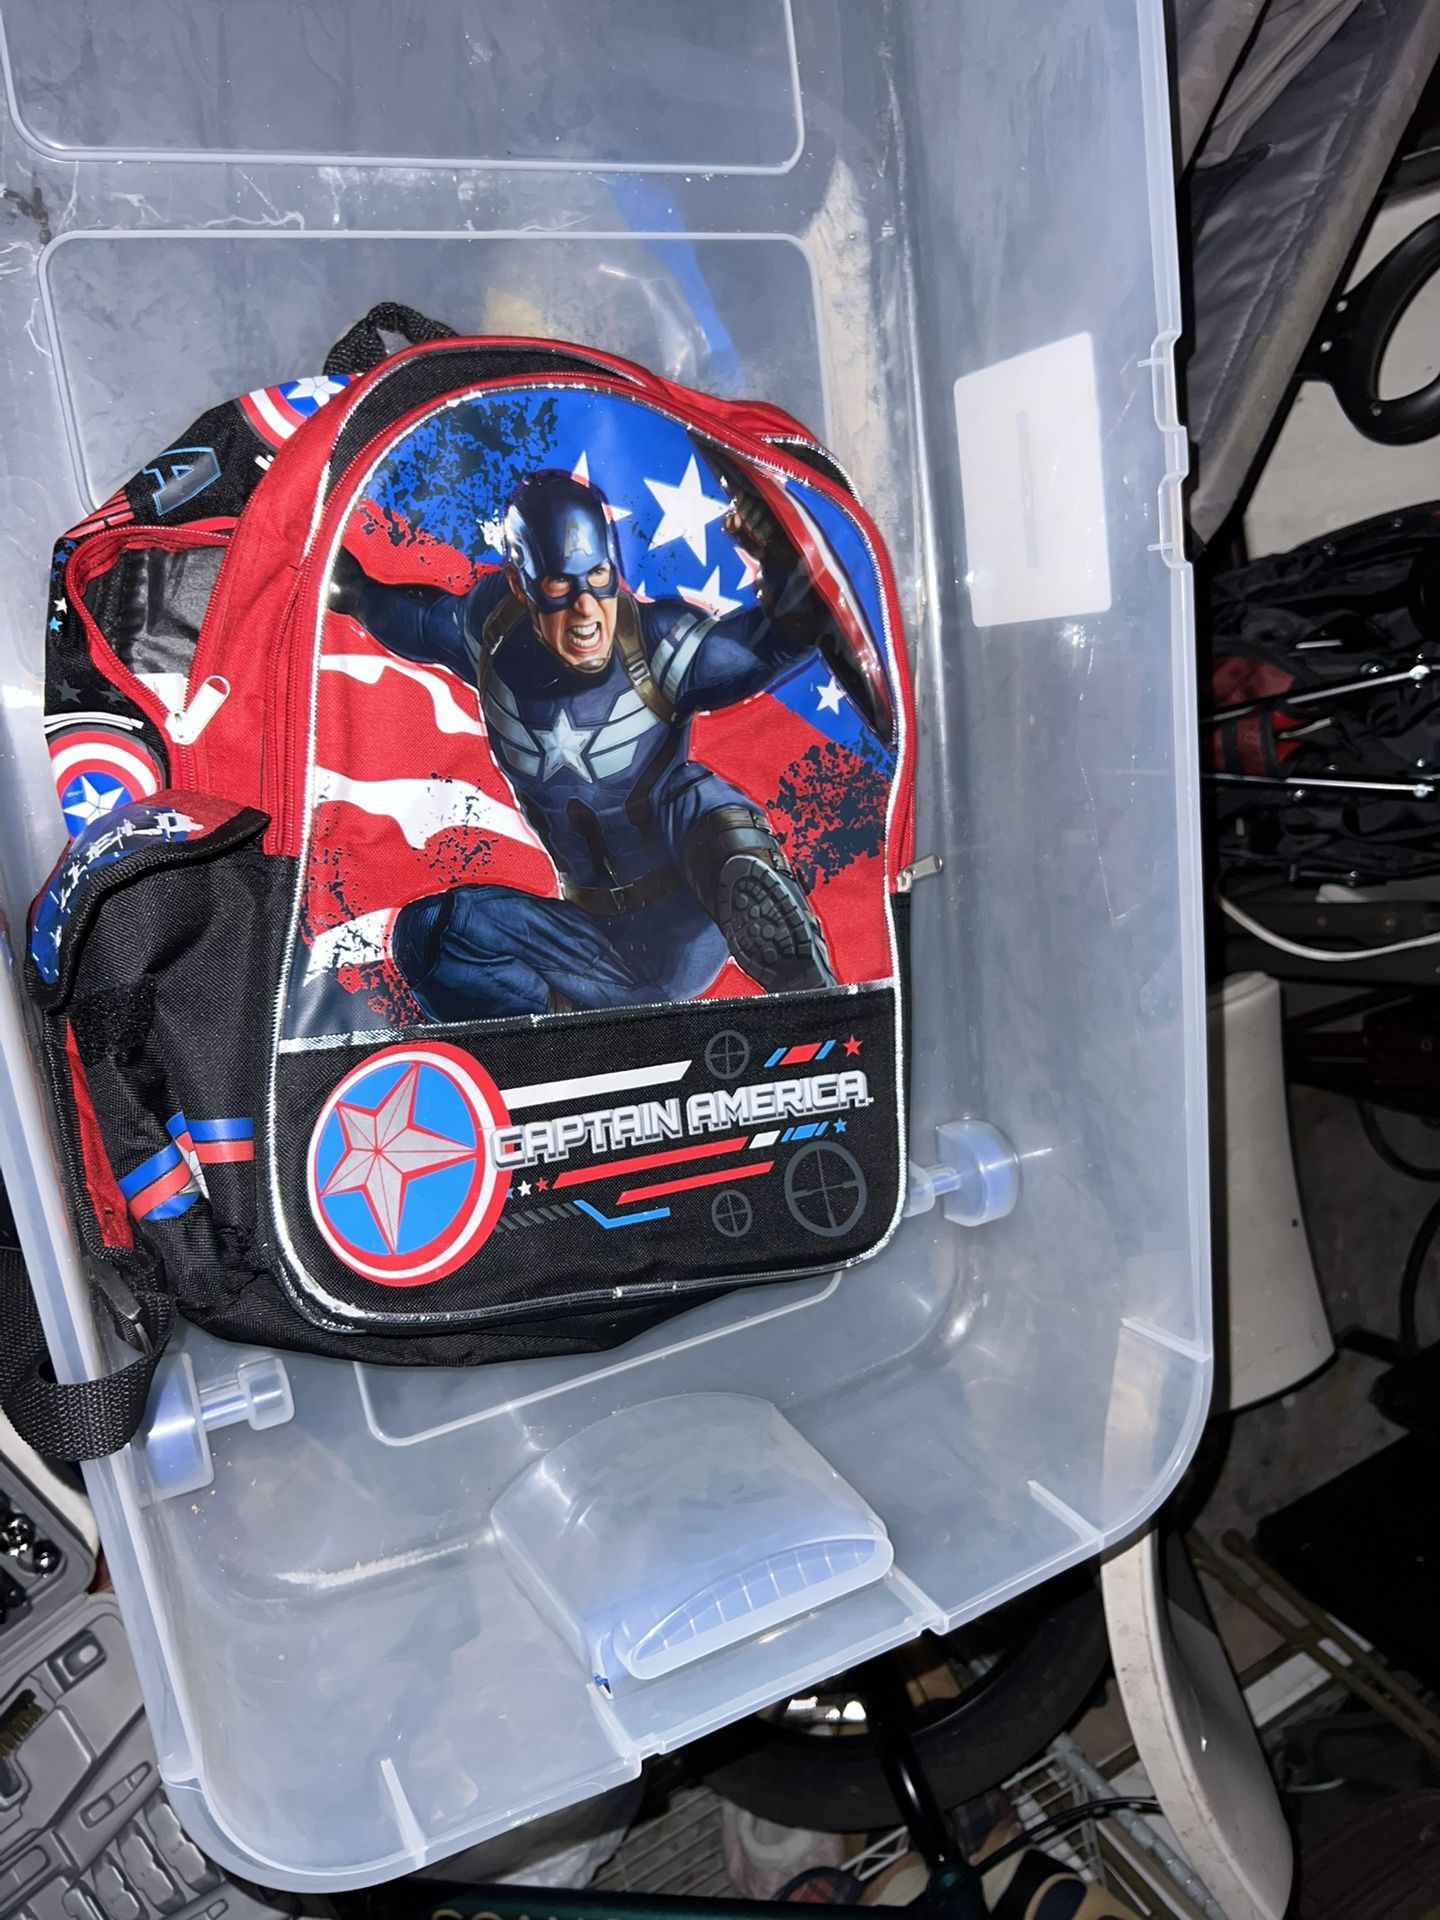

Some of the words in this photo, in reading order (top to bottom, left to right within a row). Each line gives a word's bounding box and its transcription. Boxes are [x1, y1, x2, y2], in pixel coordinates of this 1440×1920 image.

[564, 518, 593, 557] A
[491, 1098, 681, 1169] CAPTAIN
[687, 1070, 868, 1132] AMERICA
